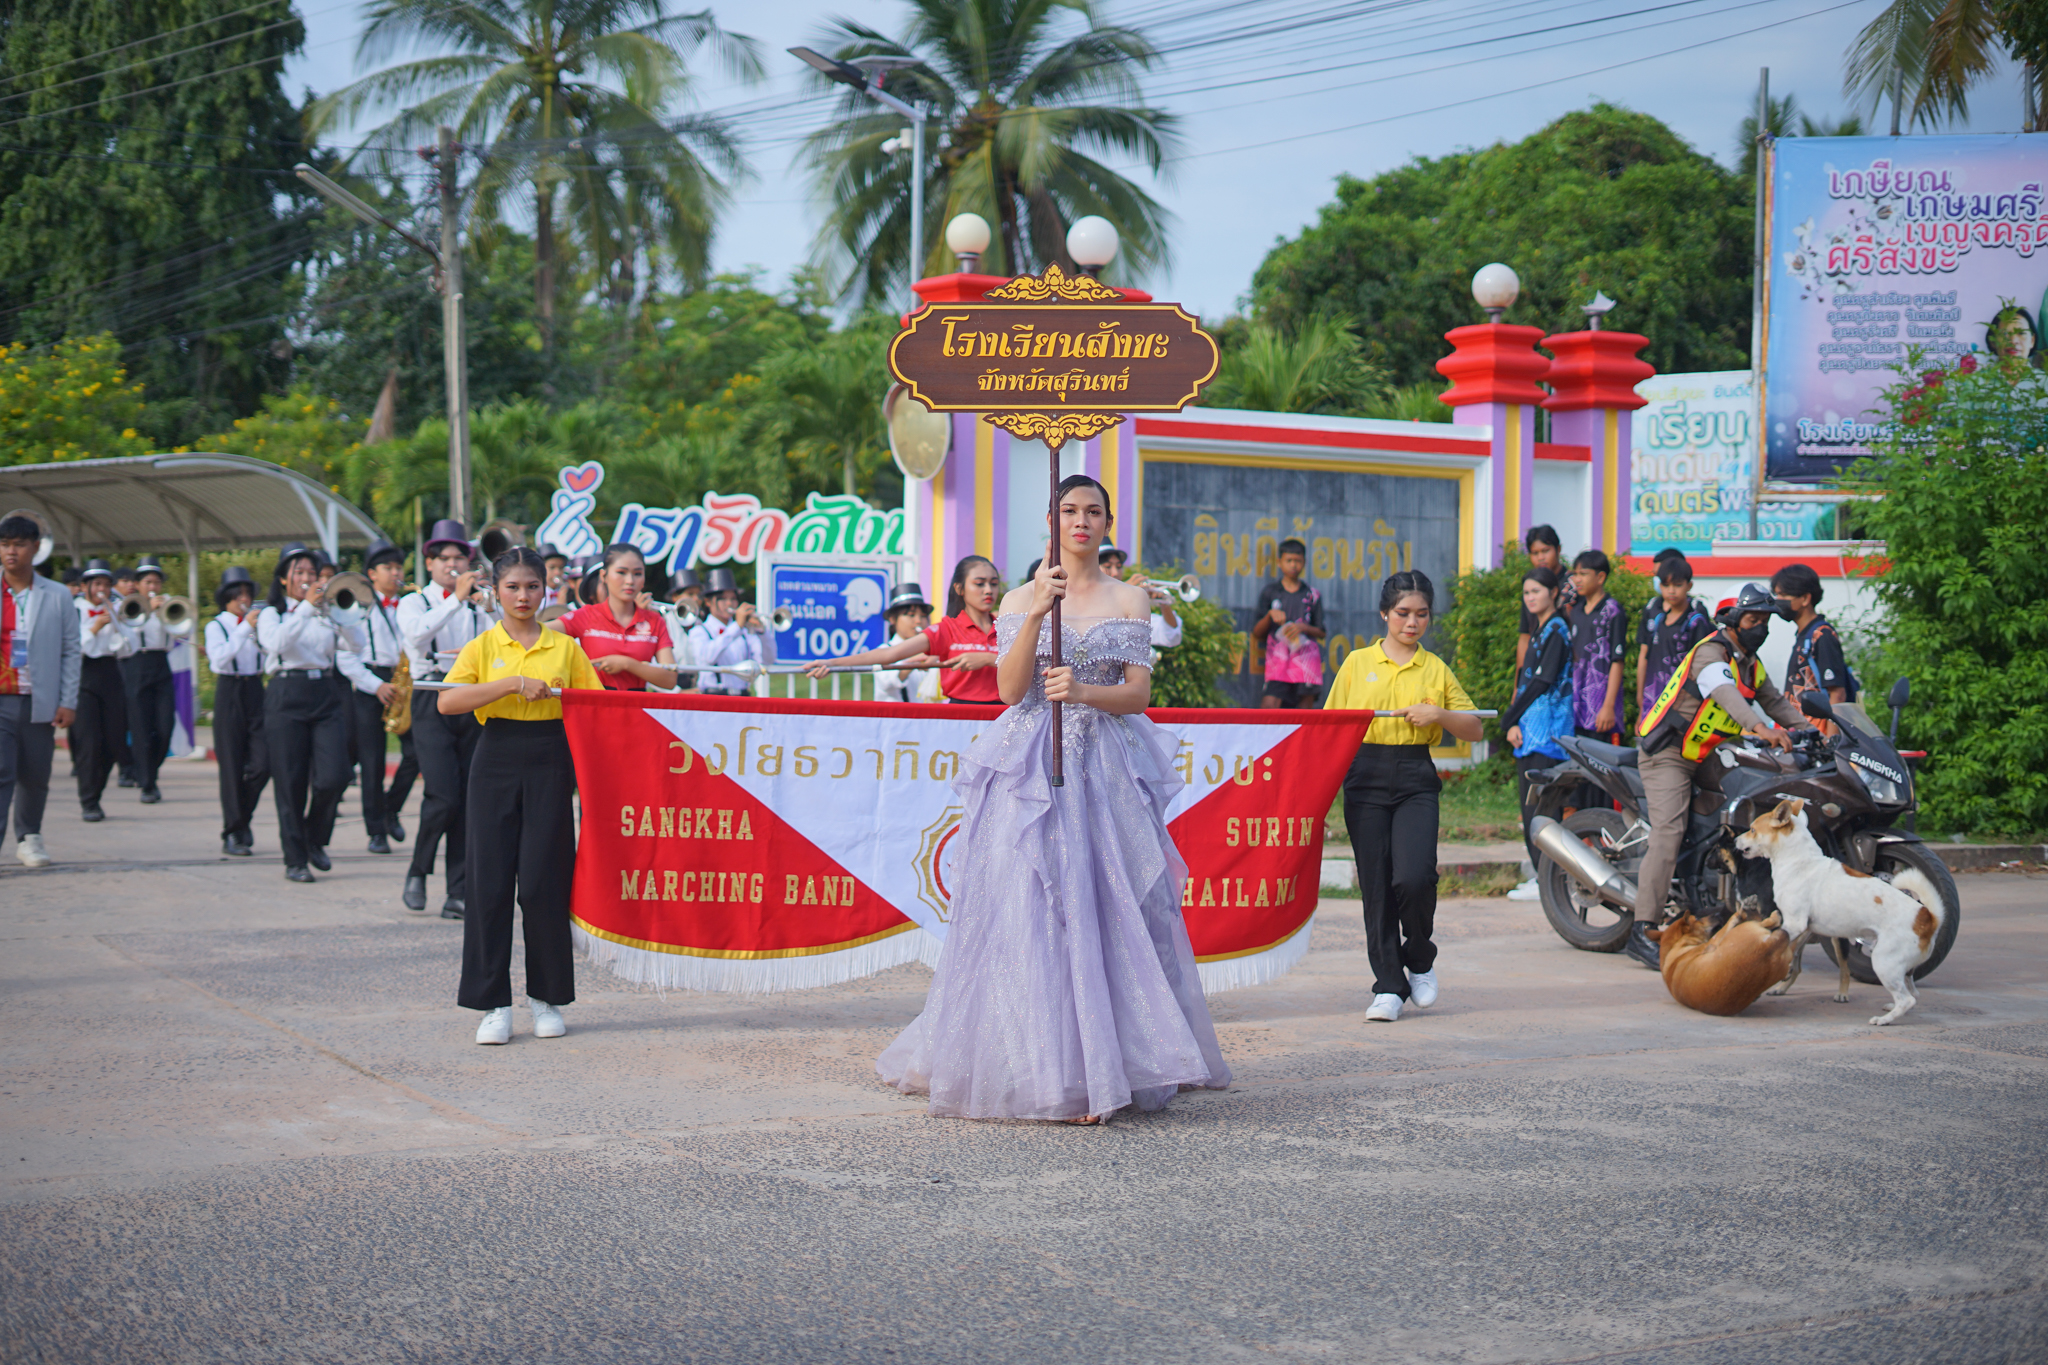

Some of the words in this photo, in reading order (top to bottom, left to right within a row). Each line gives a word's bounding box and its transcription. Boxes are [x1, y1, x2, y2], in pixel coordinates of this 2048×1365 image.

[1830, 160, 1952, 197] เกษียณ
[1906, 183, 2042, 219] เกษมศรี
[1827, 233, 1957, 270] ศรีสังขะ
[940, 314, 1170, 359] โรงเรียนสังขะ
[977, 366, 1130, 403] จังหวัดสุรินทร์
[1649, 400, 1753, 448] เรียน
[793, 626, 871, 657] 100%
[1849, 751, 1903, 785] SANGKHA
[620, 805, 754, 841] SANGKHA
[1226, 816, 1315, 847] SURIN
[620, 869, 764, 903] MARCHING
[784, 874, 856, 907] BAND
